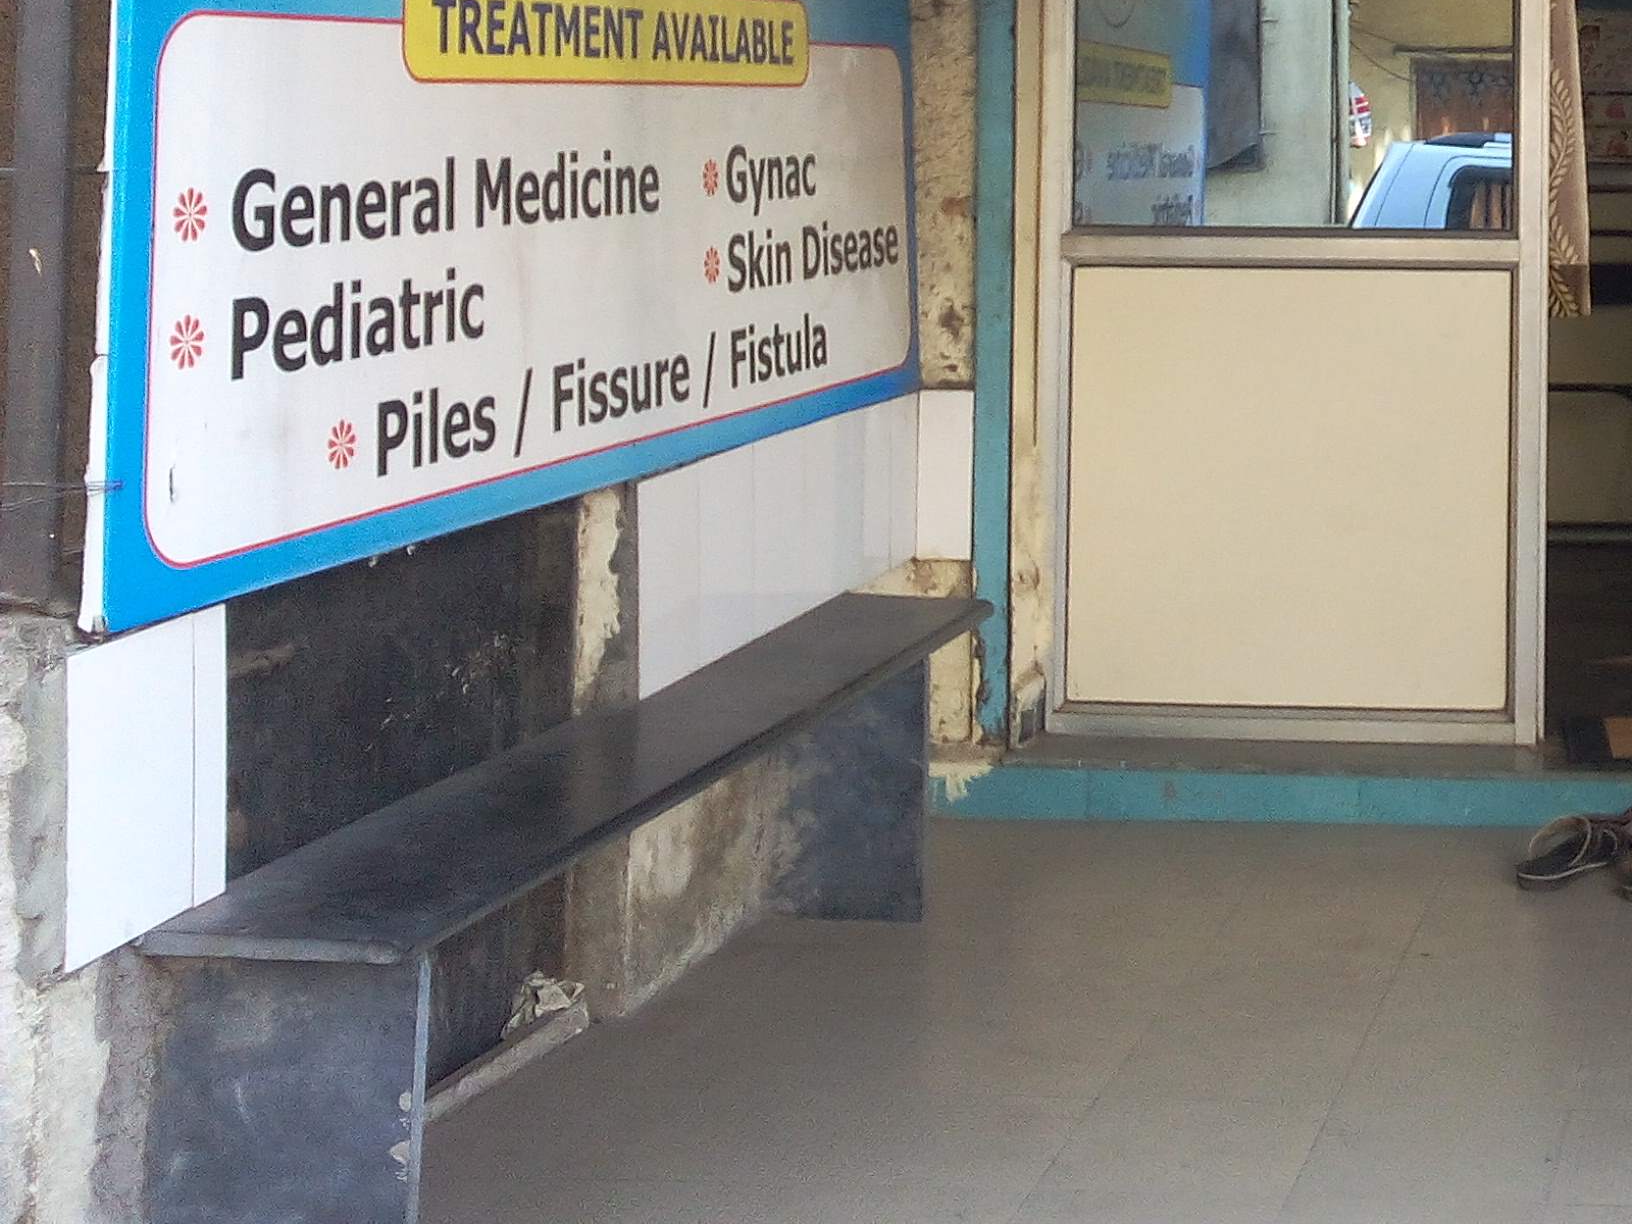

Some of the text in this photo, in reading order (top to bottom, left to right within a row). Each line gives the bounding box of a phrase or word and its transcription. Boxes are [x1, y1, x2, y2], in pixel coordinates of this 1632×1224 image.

[652, 11, 796, 66] AVAILABLE
[231, 149, 661, 253] General Medicine
[725, 145, 817, 217] Gynac
[726, 222, 900, 294] Skin Disease
[230, 268, 486, 382] Pediatric
[375, 380, 497, 478] Piles
[551, 350, 691, 434] Fissure
[729, 313, 830, 390] Fistula
